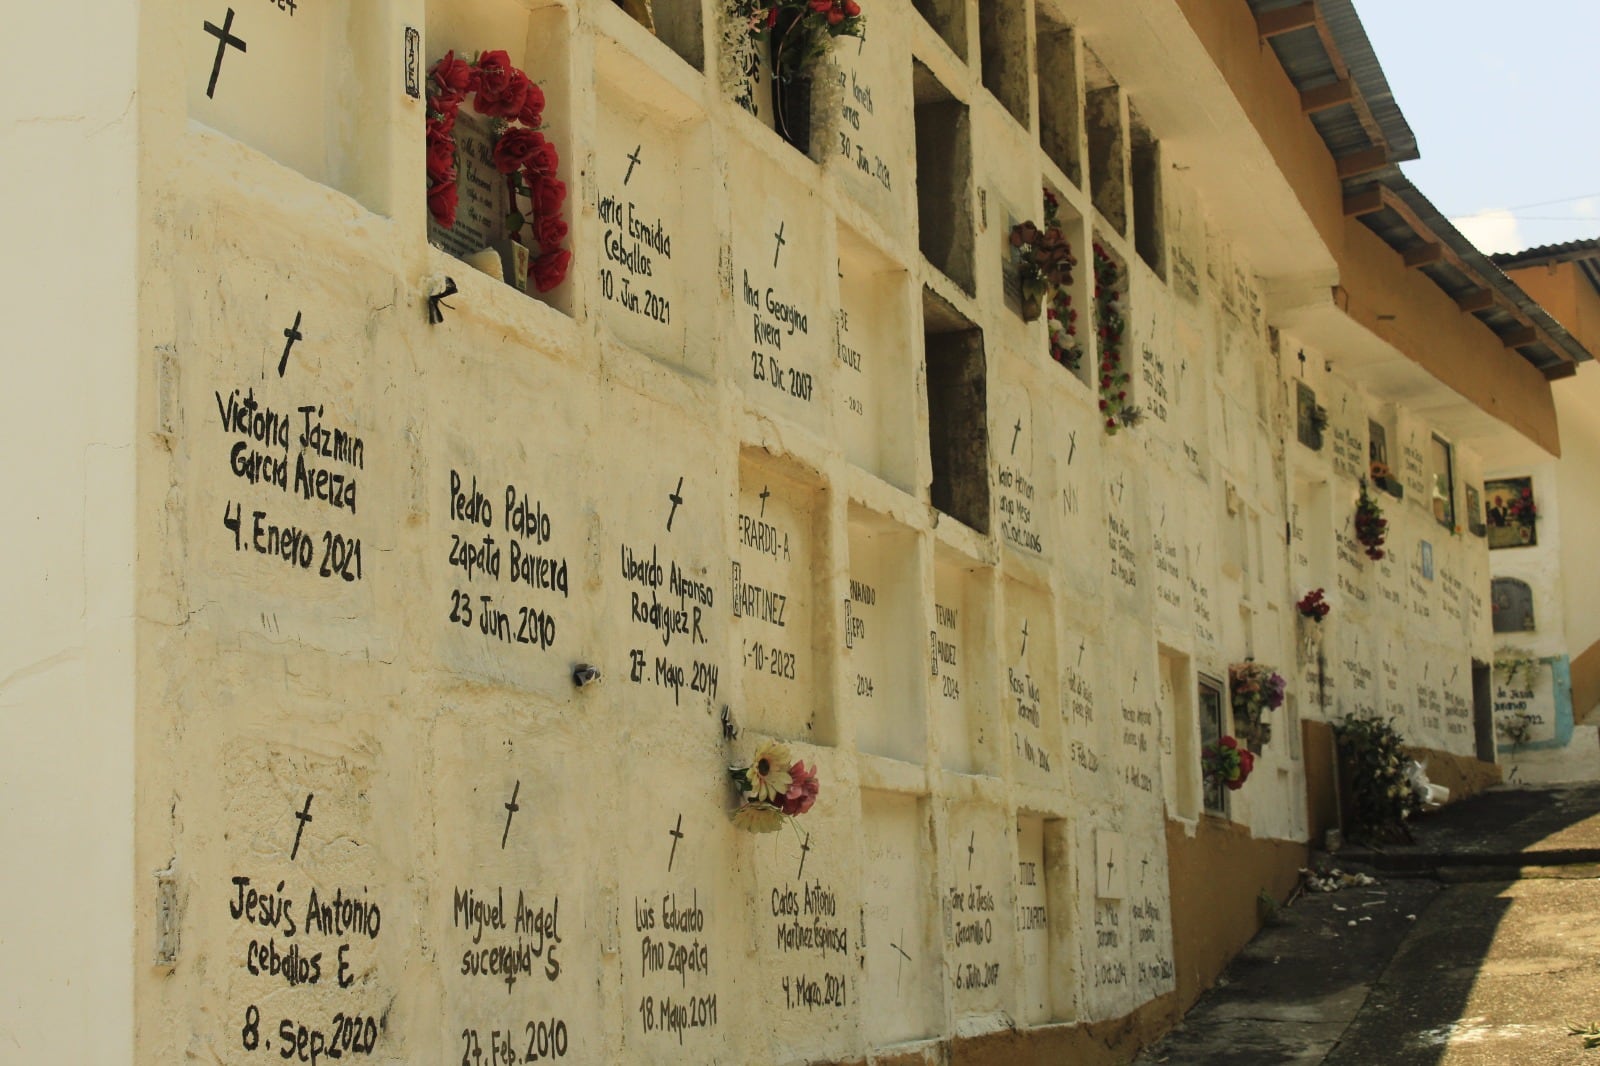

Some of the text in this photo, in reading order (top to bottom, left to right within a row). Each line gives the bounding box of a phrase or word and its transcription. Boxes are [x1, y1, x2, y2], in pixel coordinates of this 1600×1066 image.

[597, 189, 671, 259] aria Esmidia
[604, 229, 652, 277] Ceballos
[753, 313, 781, 351] Rivera
[765, 287, 808, 335] Georgina
[215, 386, 289, 453] Victoria
[294, 451, 357, 515] Areiza
[450, 469, 551, 545] Pedro Pablo
[319, 530, 362, 582] 2021
[510, 539, 569, 599] Barrera
[621, 543, 713, 611] Libardo Alfonso
[449, 589, 473, 628] 23
[741, 582, 787, 628] ARTINEZ
[229, 876, 381, 939] Jesús Antonio
[453, 885, 562, 958] Miguel Angel
[635, 887, 704, 933] Luis Eduardo
[771, 877, 836, 918] Carlos Antonio
[337, 943, 355, 988] E
[641, 935, 664, 978] Pino
